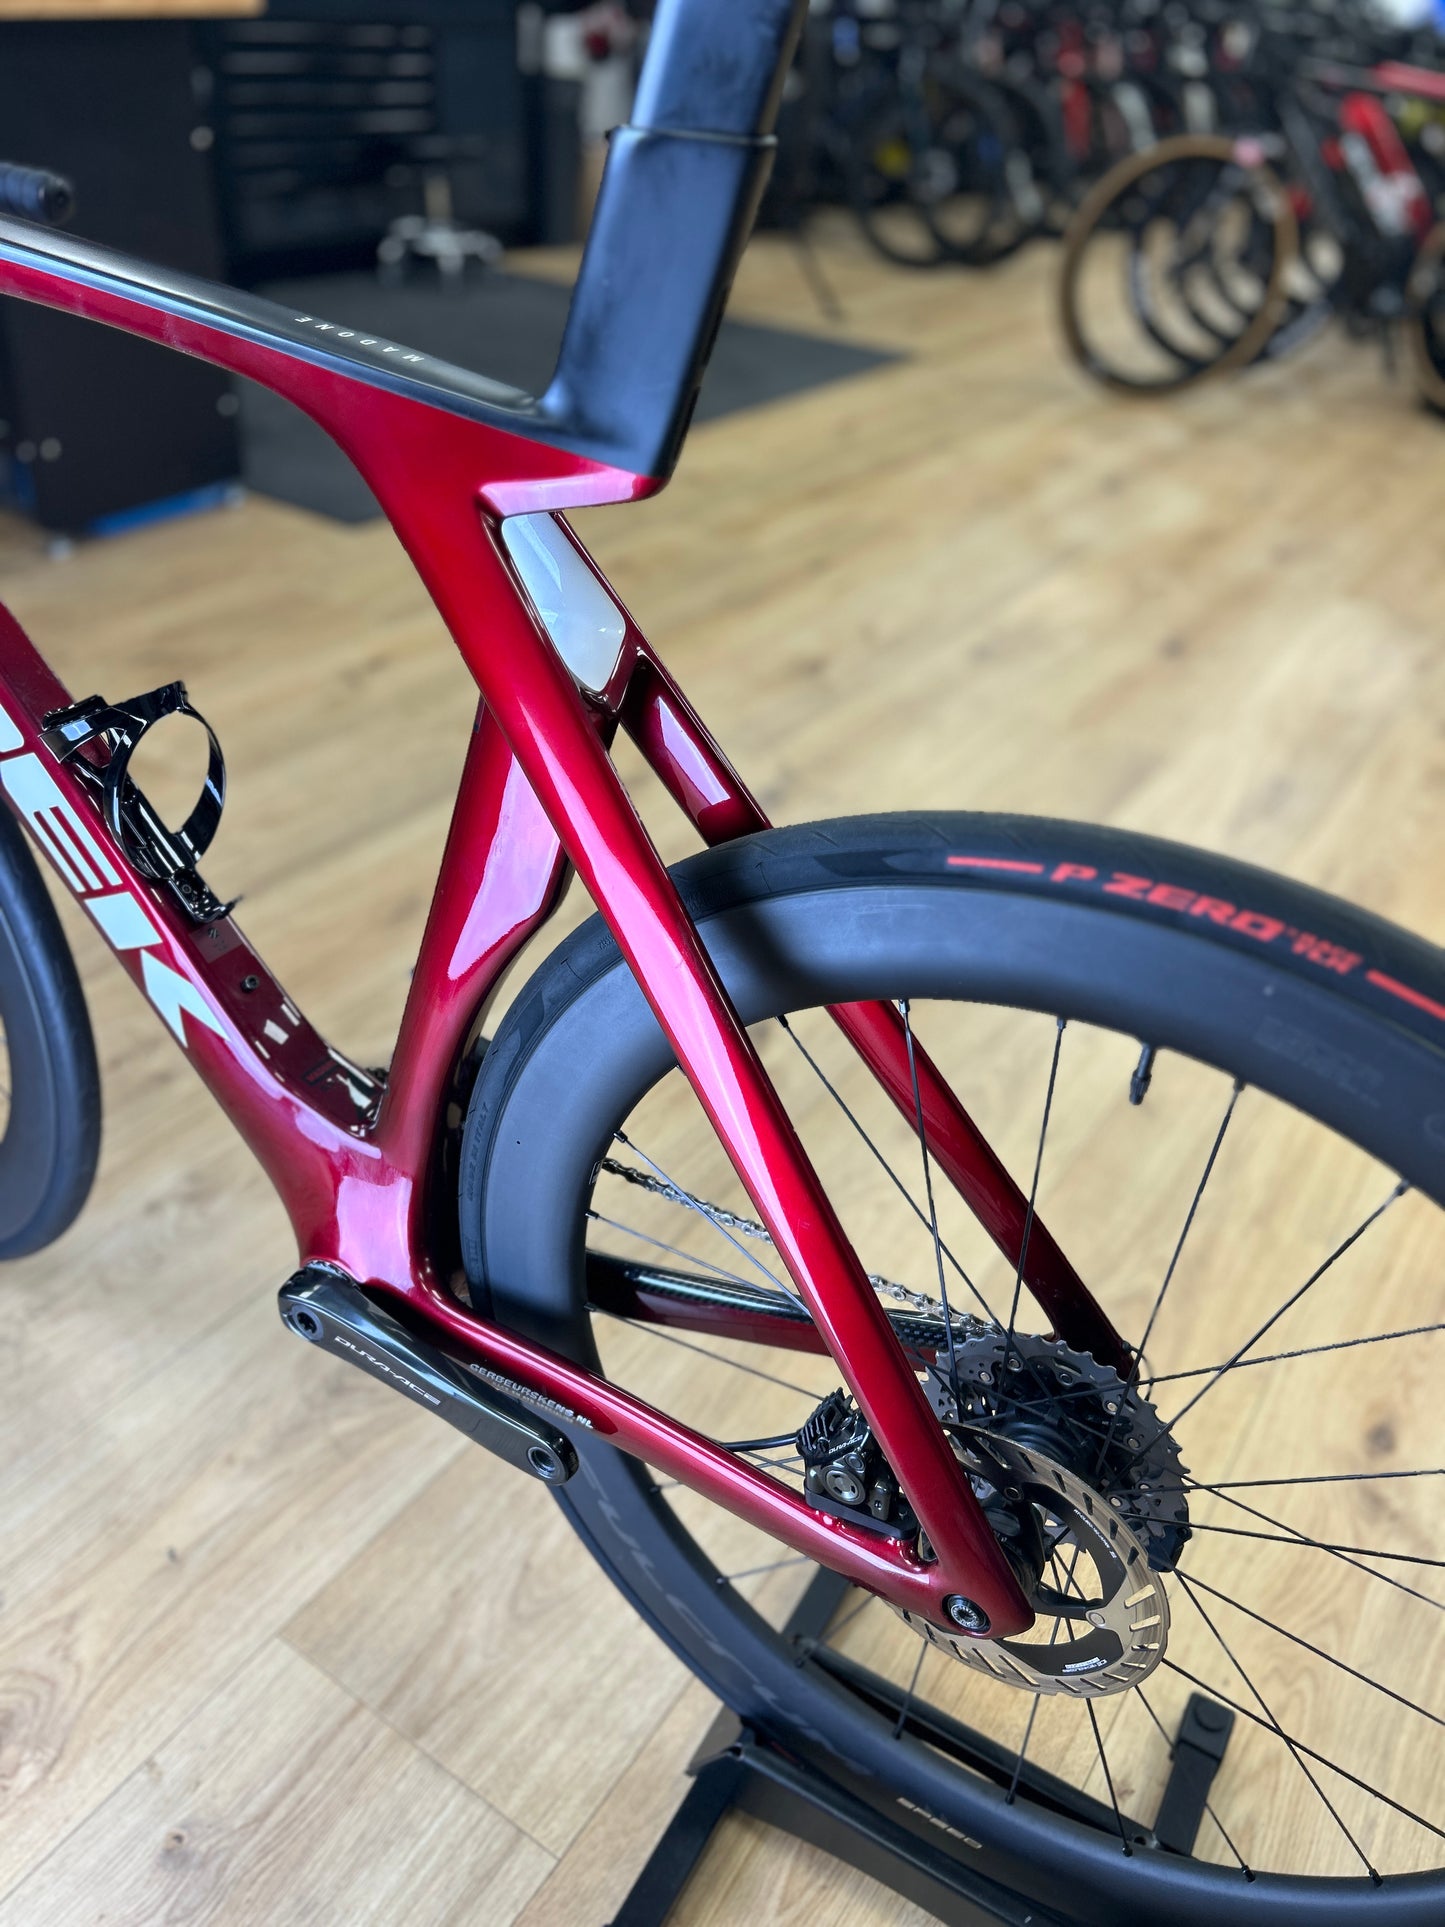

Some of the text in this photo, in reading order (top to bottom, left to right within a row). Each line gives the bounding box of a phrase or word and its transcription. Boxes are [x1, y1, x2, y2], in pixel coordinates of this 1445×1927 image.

[294, 316, 425, 363] MADONE
[0, 704, 232, 1049] EK
[1050, 862, 1286, 942] P ZERO
[334, 1335, 441, 1406] DURA-ACE
[469, 1362, 594, 1430] GERBEURSKENS.NL
